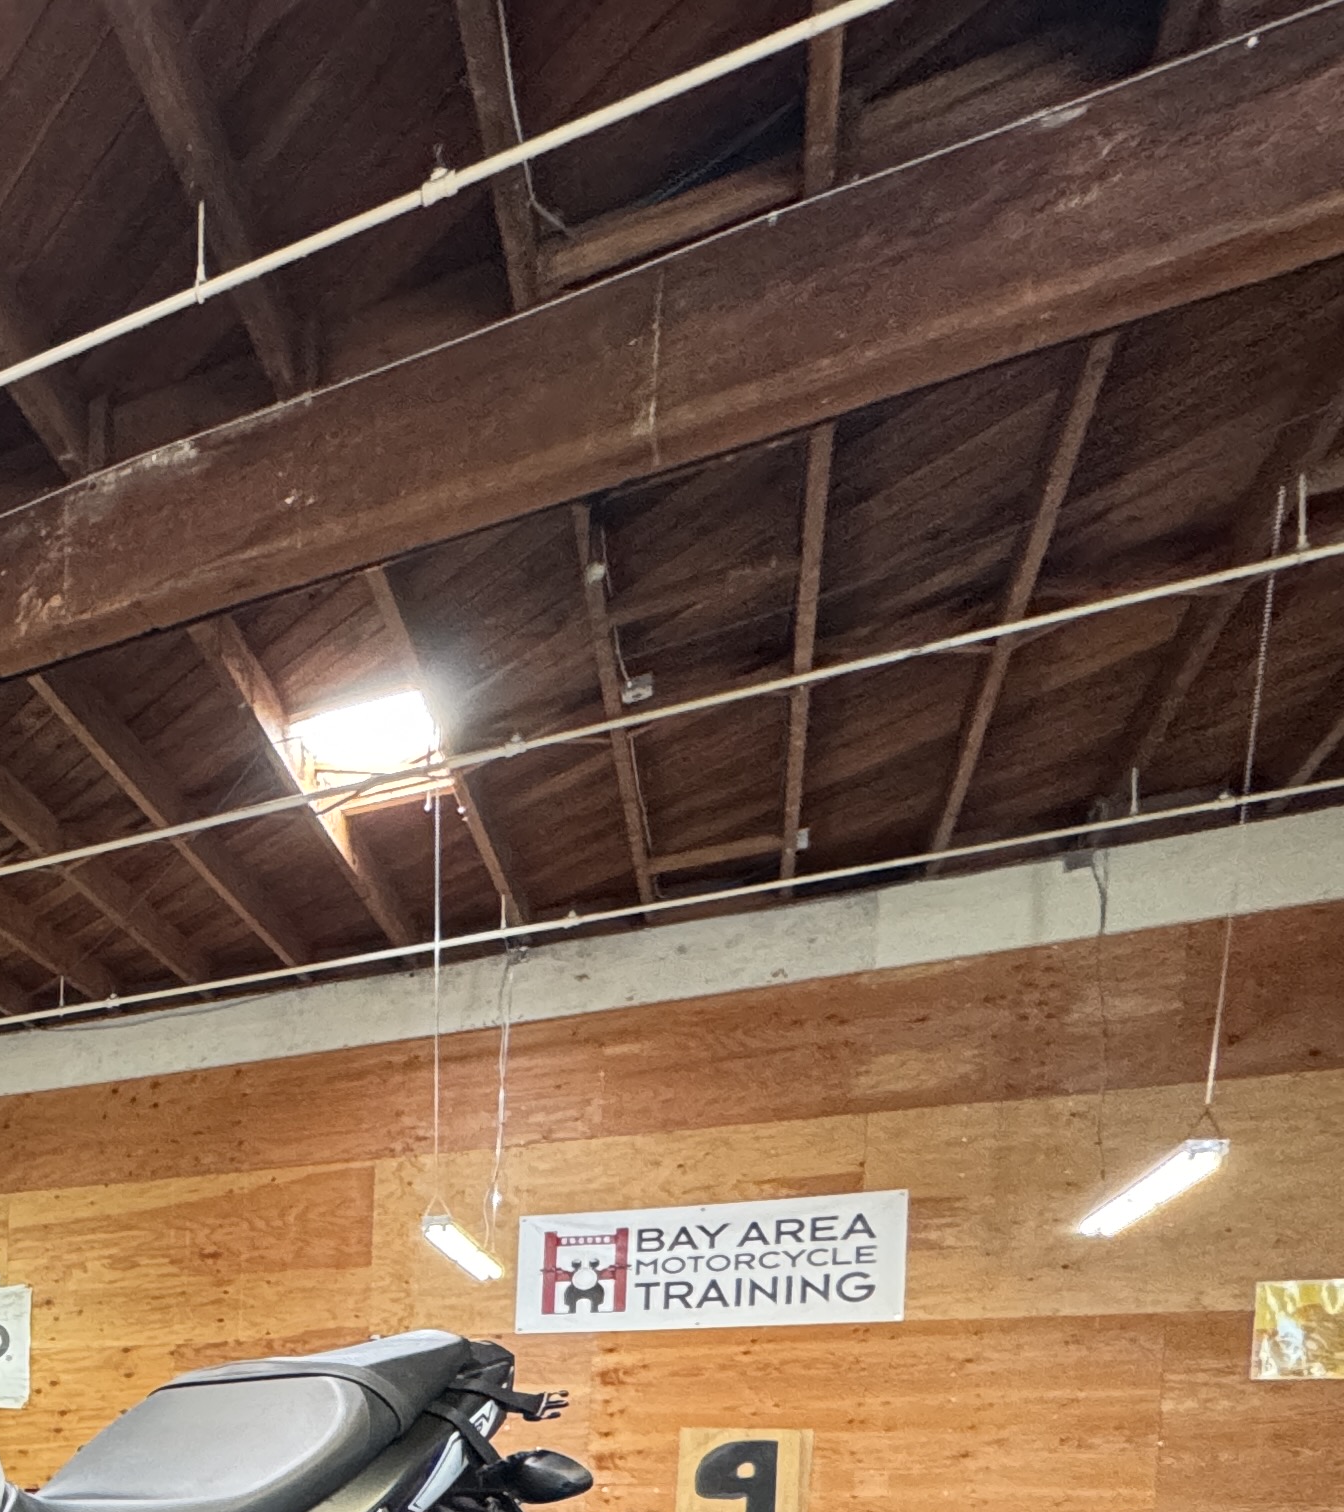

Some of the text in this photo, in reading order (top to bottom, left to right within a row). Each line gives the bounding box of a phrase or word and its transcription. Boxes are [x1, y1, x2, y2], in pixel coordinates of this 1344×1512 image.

[636, 1213, 877, 1252] BAY AREA
[635, 1245, 878, 1275] MOTORCYCLE
[634, 1272, 876, 1311] TRAINING
